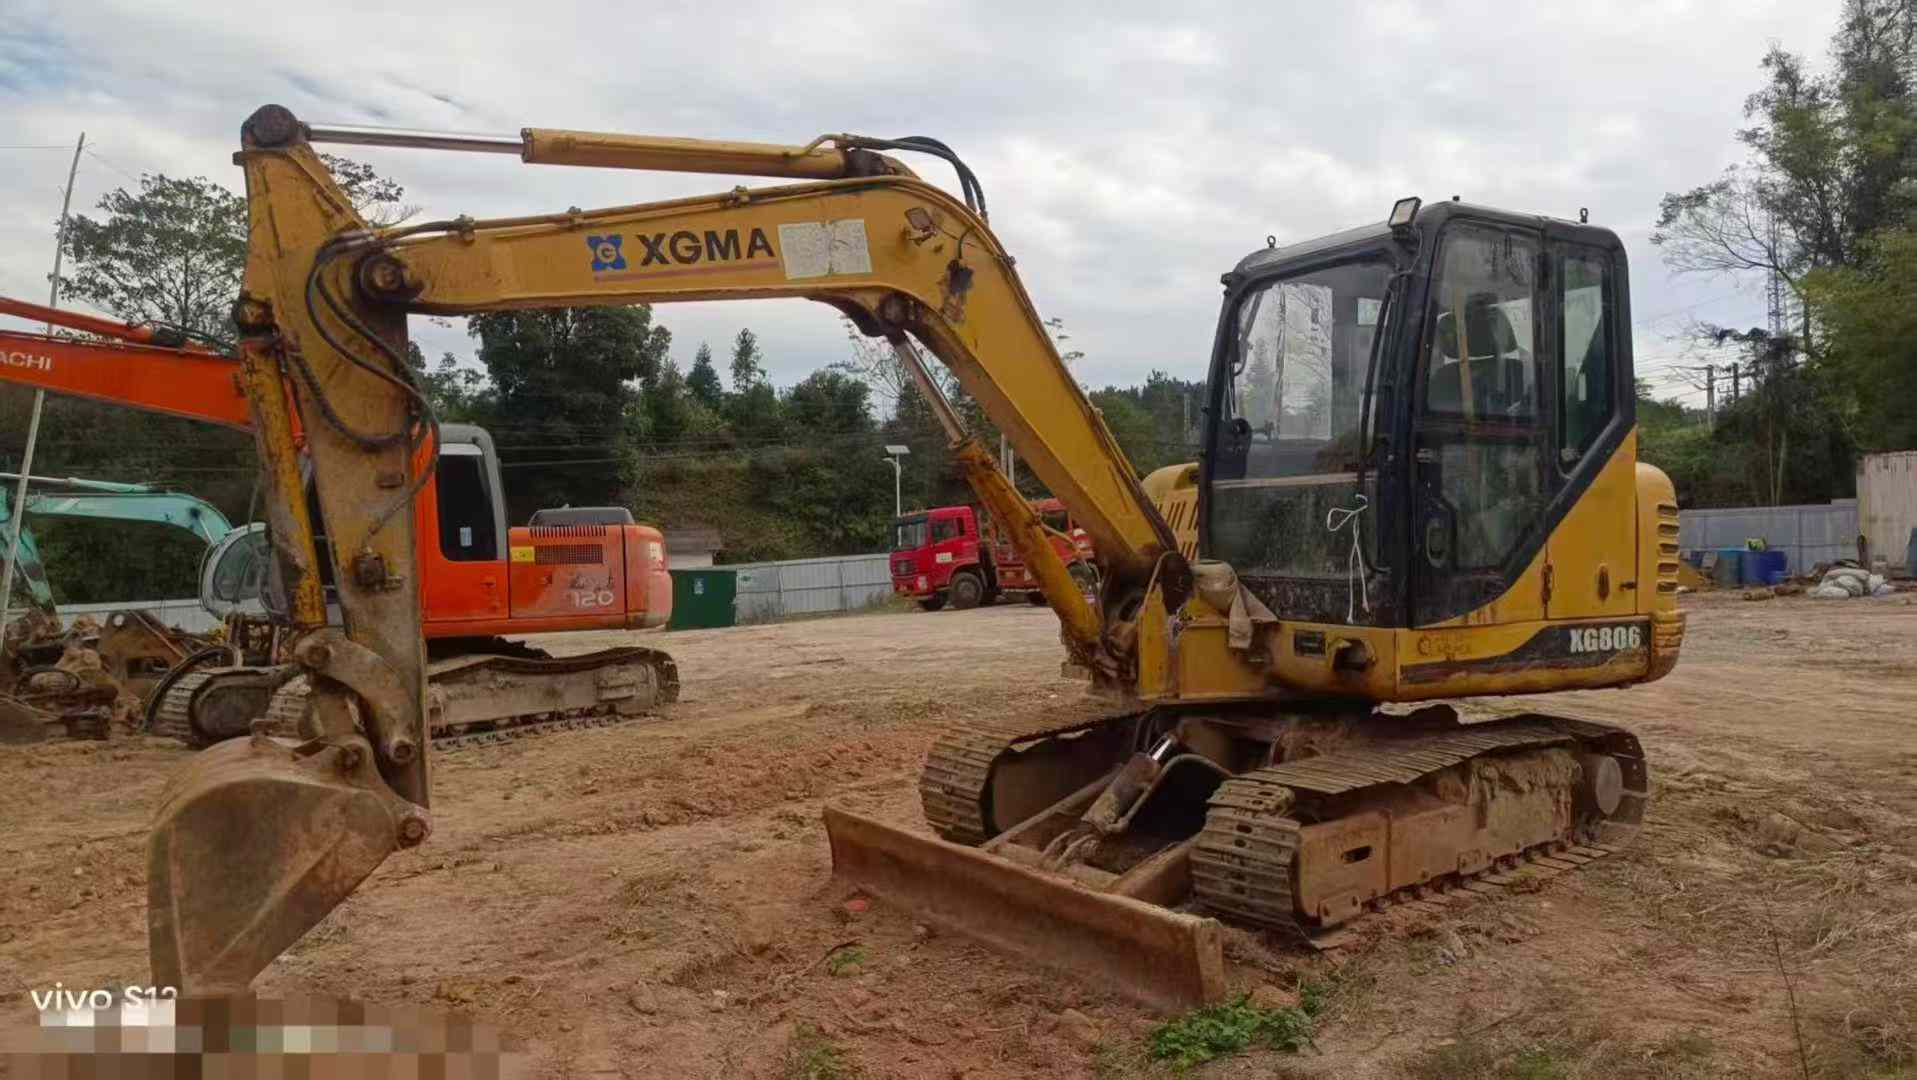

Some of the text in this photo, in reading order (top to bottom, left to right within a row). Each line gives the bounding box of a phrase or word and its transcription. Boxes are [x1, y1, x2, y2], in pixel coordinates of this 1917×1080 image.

[635, 227, 776, 267] XGMA
[572, 590, 614, 608] 120
[1569, 625, 1641, 653] XG806
